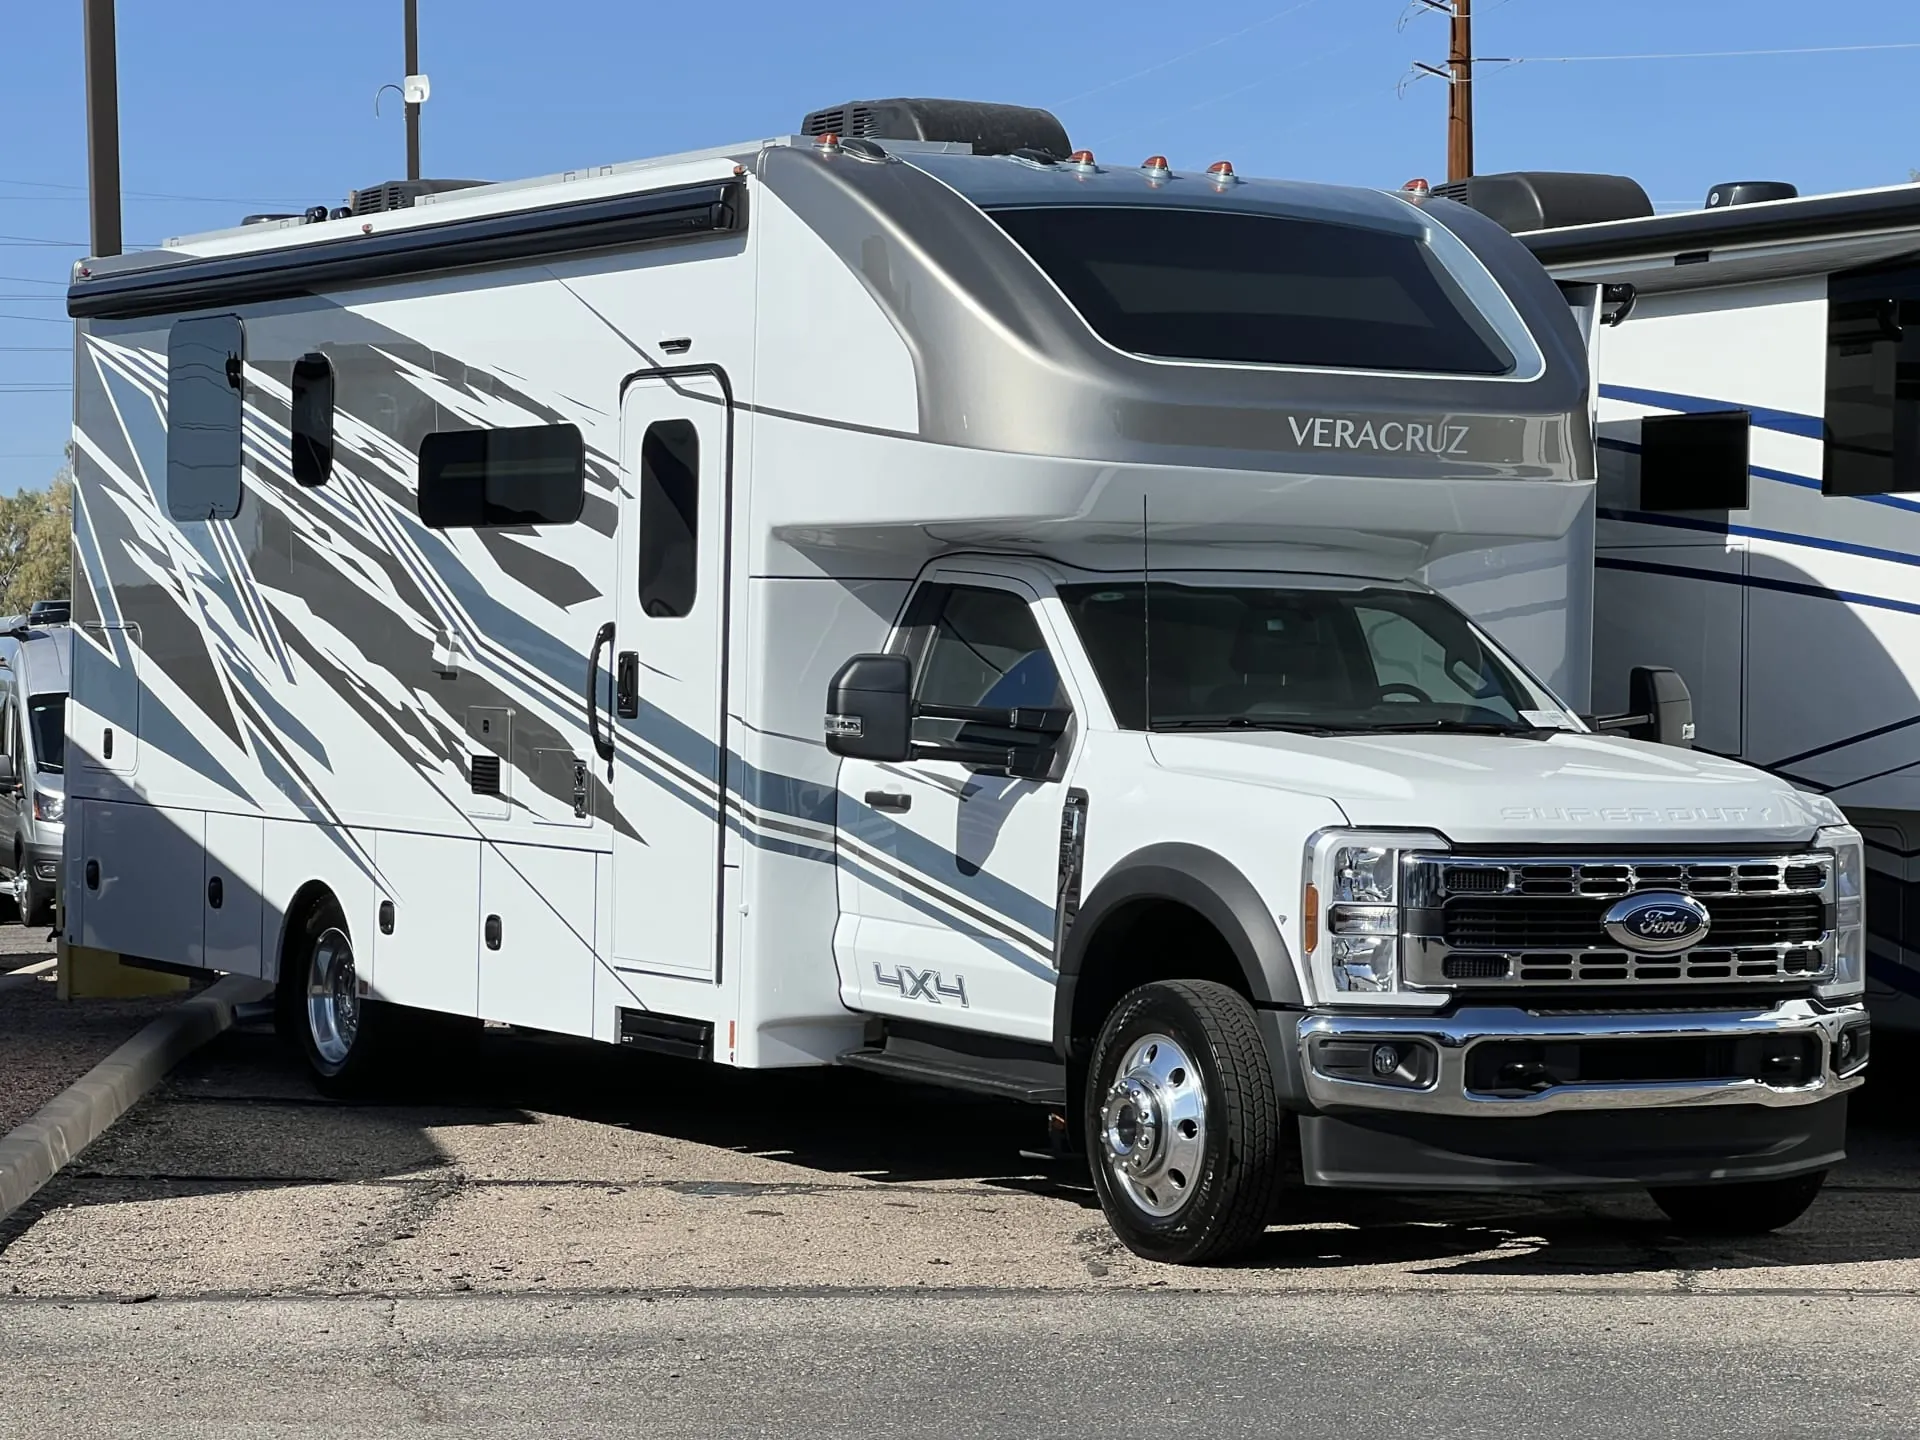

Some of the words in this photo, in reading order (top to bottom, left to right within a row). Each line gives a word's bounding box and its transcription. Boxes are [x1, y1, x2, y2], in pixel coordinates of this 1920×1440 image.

[1288, 416, 1469, 454] VERACRUZ
[1500, 805, 1662, 822] SUPER
[1640, 910, 1688, 934] Ford
